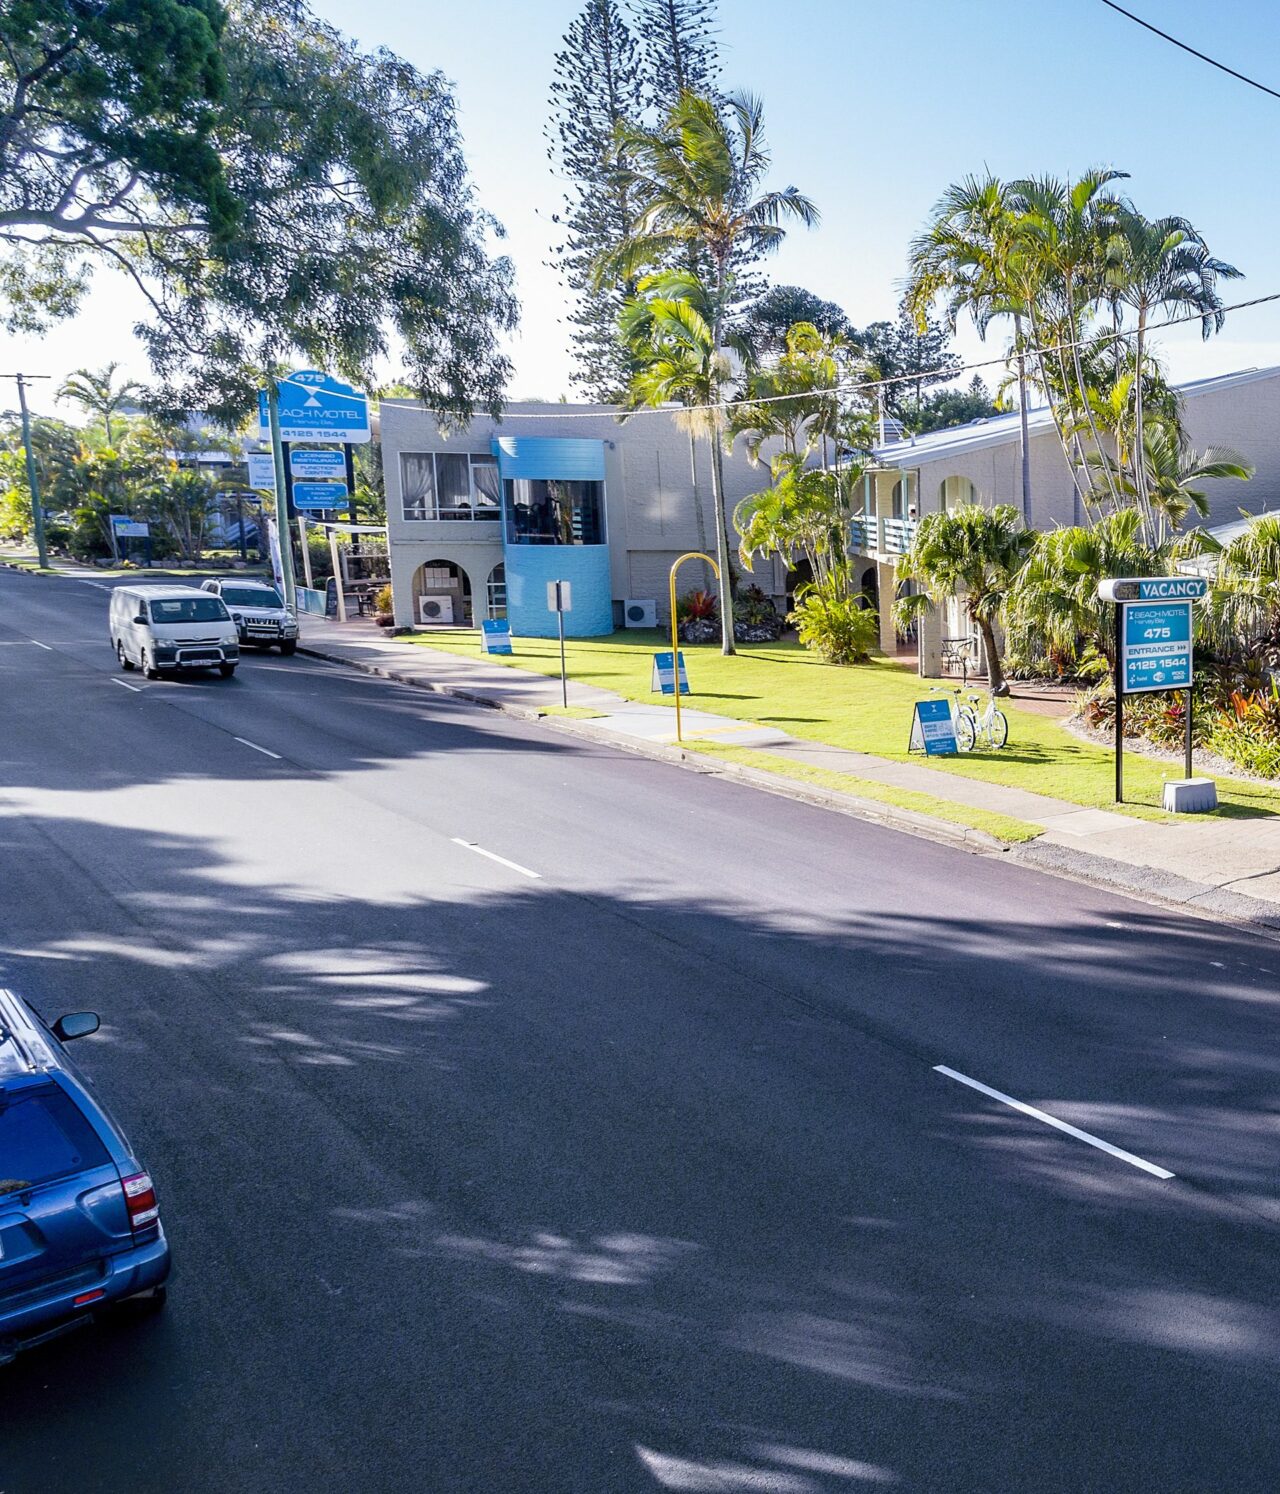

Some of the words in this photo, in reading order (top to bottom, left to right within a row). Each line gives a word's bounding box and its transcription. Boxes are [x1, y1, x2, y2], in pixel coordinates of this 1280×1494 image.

[294, 374, 326, 383] 475
[314, 409, 363, 419] MOTEL
[1142, 582, 1203, 596] VACANCY
[1134, 610, 1161, 619] BEACH
[1161, 609, 1188, 617] MOTEL
[1143, 627, 1171, 639] 475
[1128, 645, 1175, 655] ENTRANCE
[1128, 660, 1157, 670] 4125
[1159, 657, 1187, 668] 1544
